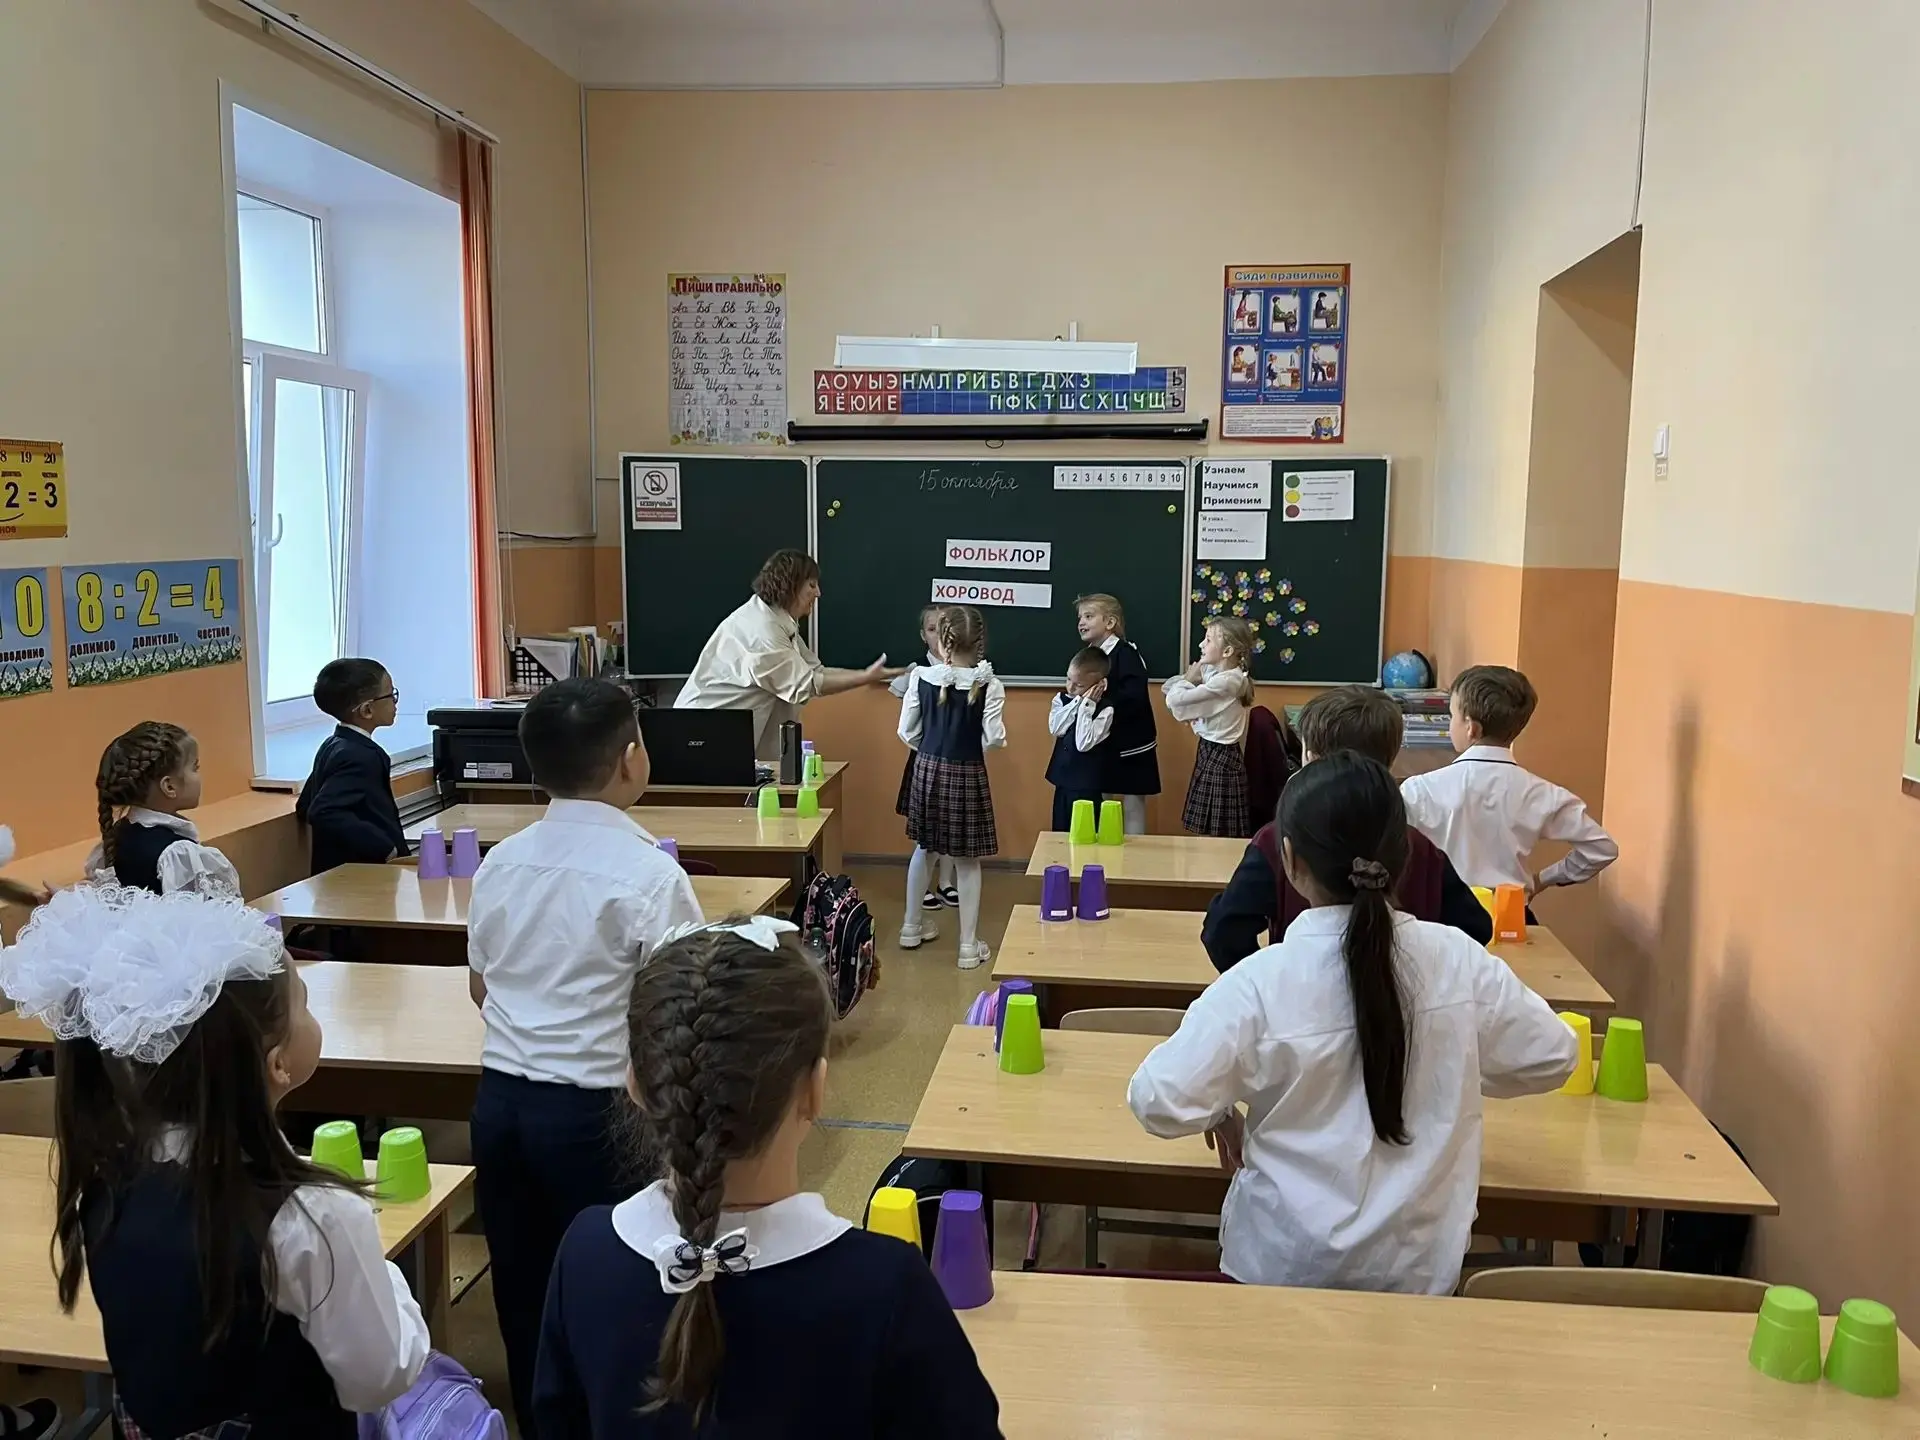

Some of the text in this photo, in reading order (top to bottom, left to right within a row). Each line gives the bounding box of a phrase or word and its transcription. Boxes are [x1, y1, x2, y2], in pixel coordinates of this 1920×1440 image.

[1234, 270, 1339, 282] Сиди правильно
[20, 451, 32, 463] 19
[44, 452, 56, 464] 20
[1204, 466, 1246, 475] Узнаем
[919, 469, 1019, 498] 15 октября
[1171, 474, 1181, 482] 10
[1204, 481, 1259, 491] Научимся
[5, 482, 20, 508] 2
[44, 482, 58, 508] 3
[1203, 496, 1262, 506] Применим
[949, 547, 1045, 564] ФОЛЬКЛОР
[935, 585, 1015, 605] ХОРОВОД
